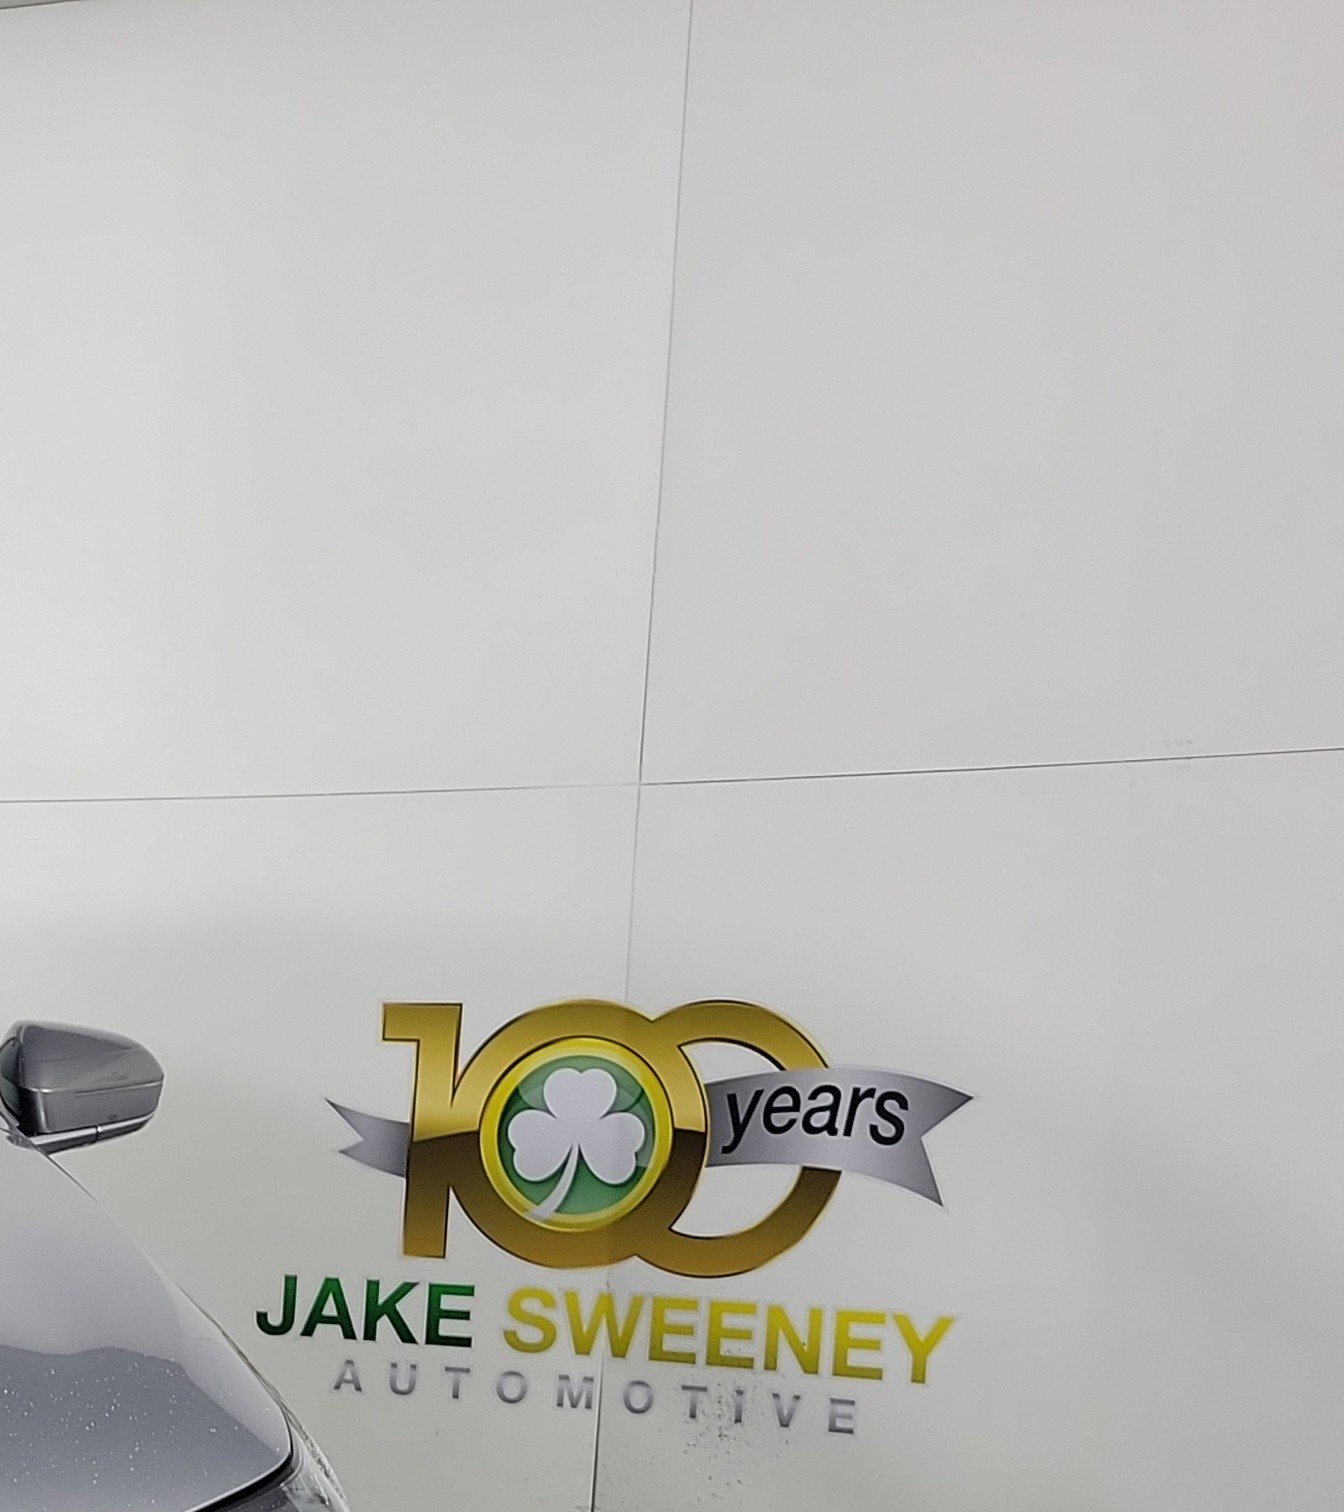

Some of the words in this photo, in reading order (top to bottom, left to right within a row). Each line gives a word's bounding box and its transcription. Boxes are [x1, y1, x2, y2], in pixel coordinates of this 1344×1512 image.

[381, 998, 842, 1279] 100
[720, 1082, 910, 1155] years
[255, 1273, 476, 1350] JAKE
[503, 1287, 955, 1385] SWEENEY
[332, 1359, 857, 1436] AUTOMOTIVE
